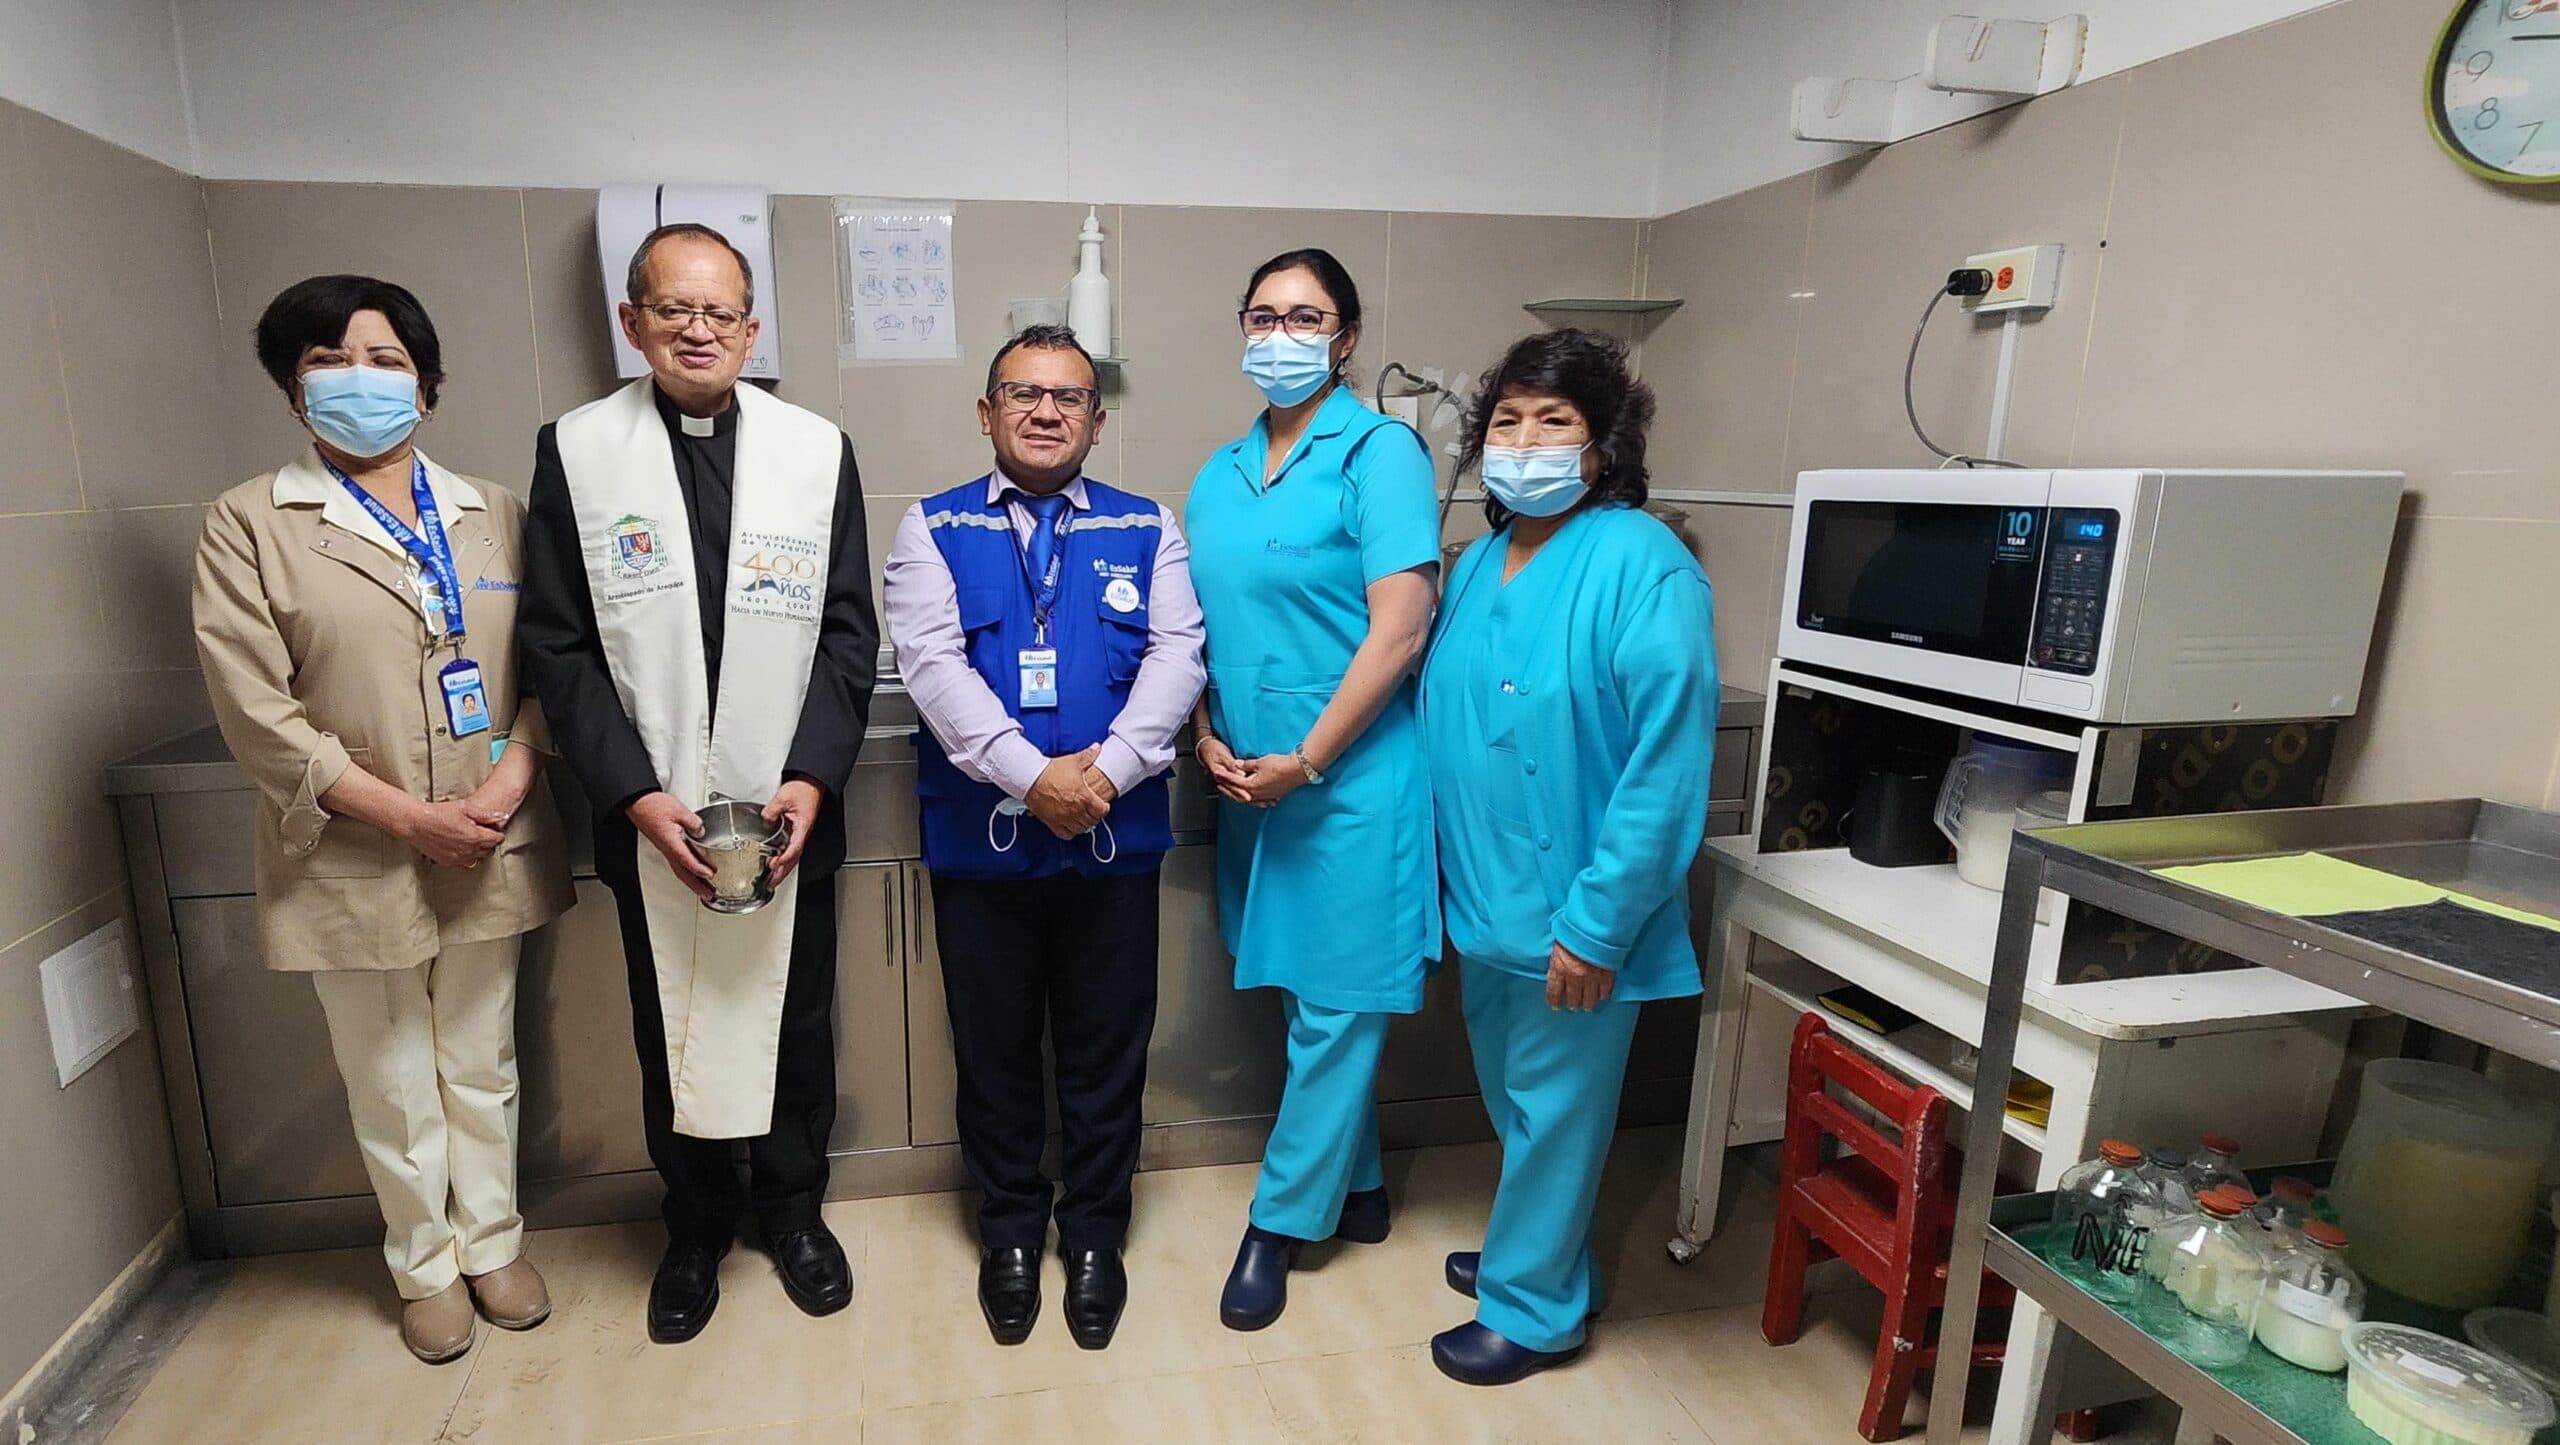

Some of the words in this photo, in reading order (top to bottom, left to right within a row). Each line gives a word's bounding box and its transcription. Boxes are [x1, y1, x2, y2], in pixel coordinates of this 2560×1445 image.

[2466, 50, 2494, 82] 9
[2474, 97, 2500, 130] 8
[2516, 120, 2545, 156] 7
[363, 497, 400, 530] EsSalud
[2007, 511, 2032, 537] 10
[2006, 537, 2026, 546] YEAR
[2080, 524, 2103, 537] 140
[1890, 631, 1923, 643] SAMSUNG
